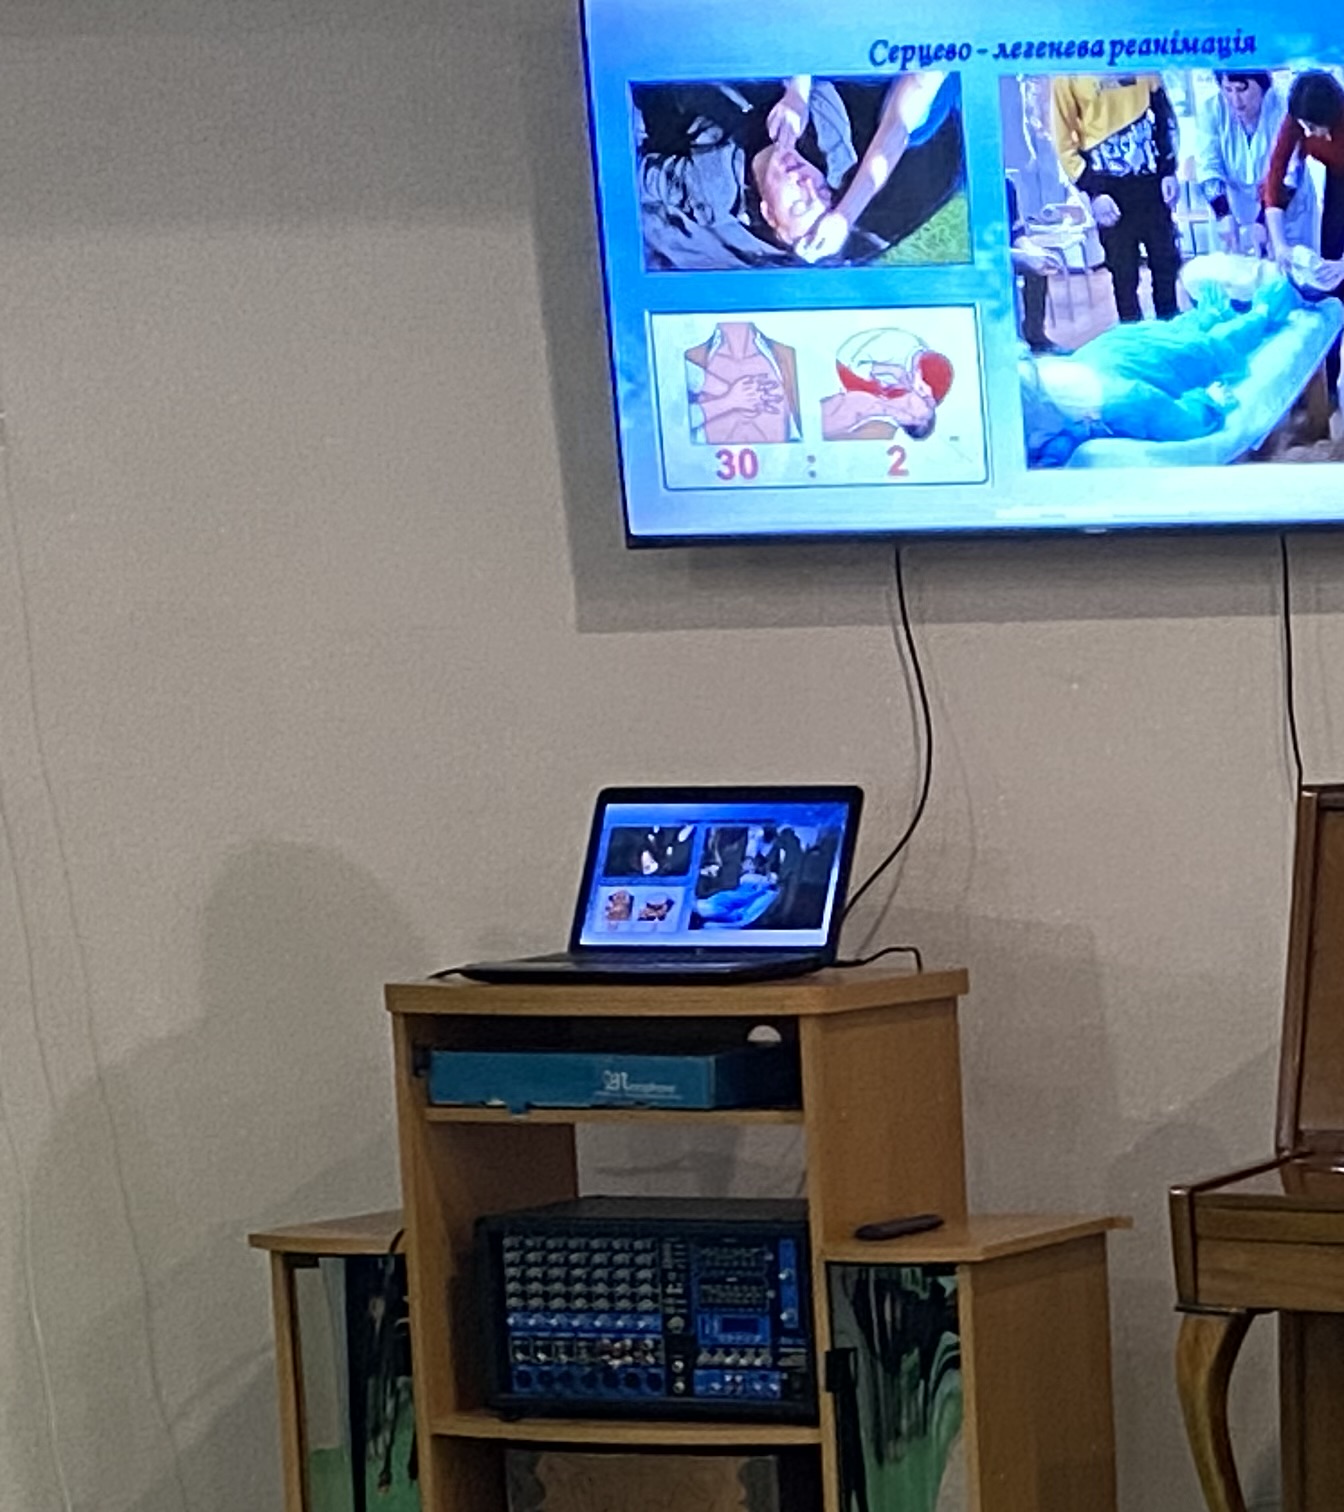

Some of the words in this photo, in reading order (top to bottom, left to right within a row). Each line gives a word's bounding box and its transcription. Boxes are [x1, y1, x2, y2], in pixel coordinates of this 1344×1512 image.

[869, 39, 972, 70] Серцево
[992, 39, 1105, 60] легенева
[1107, 28, 1257, 67] реанімація
[715, 448, 758, 480] 30
[886, 445, 909, 476] 2
